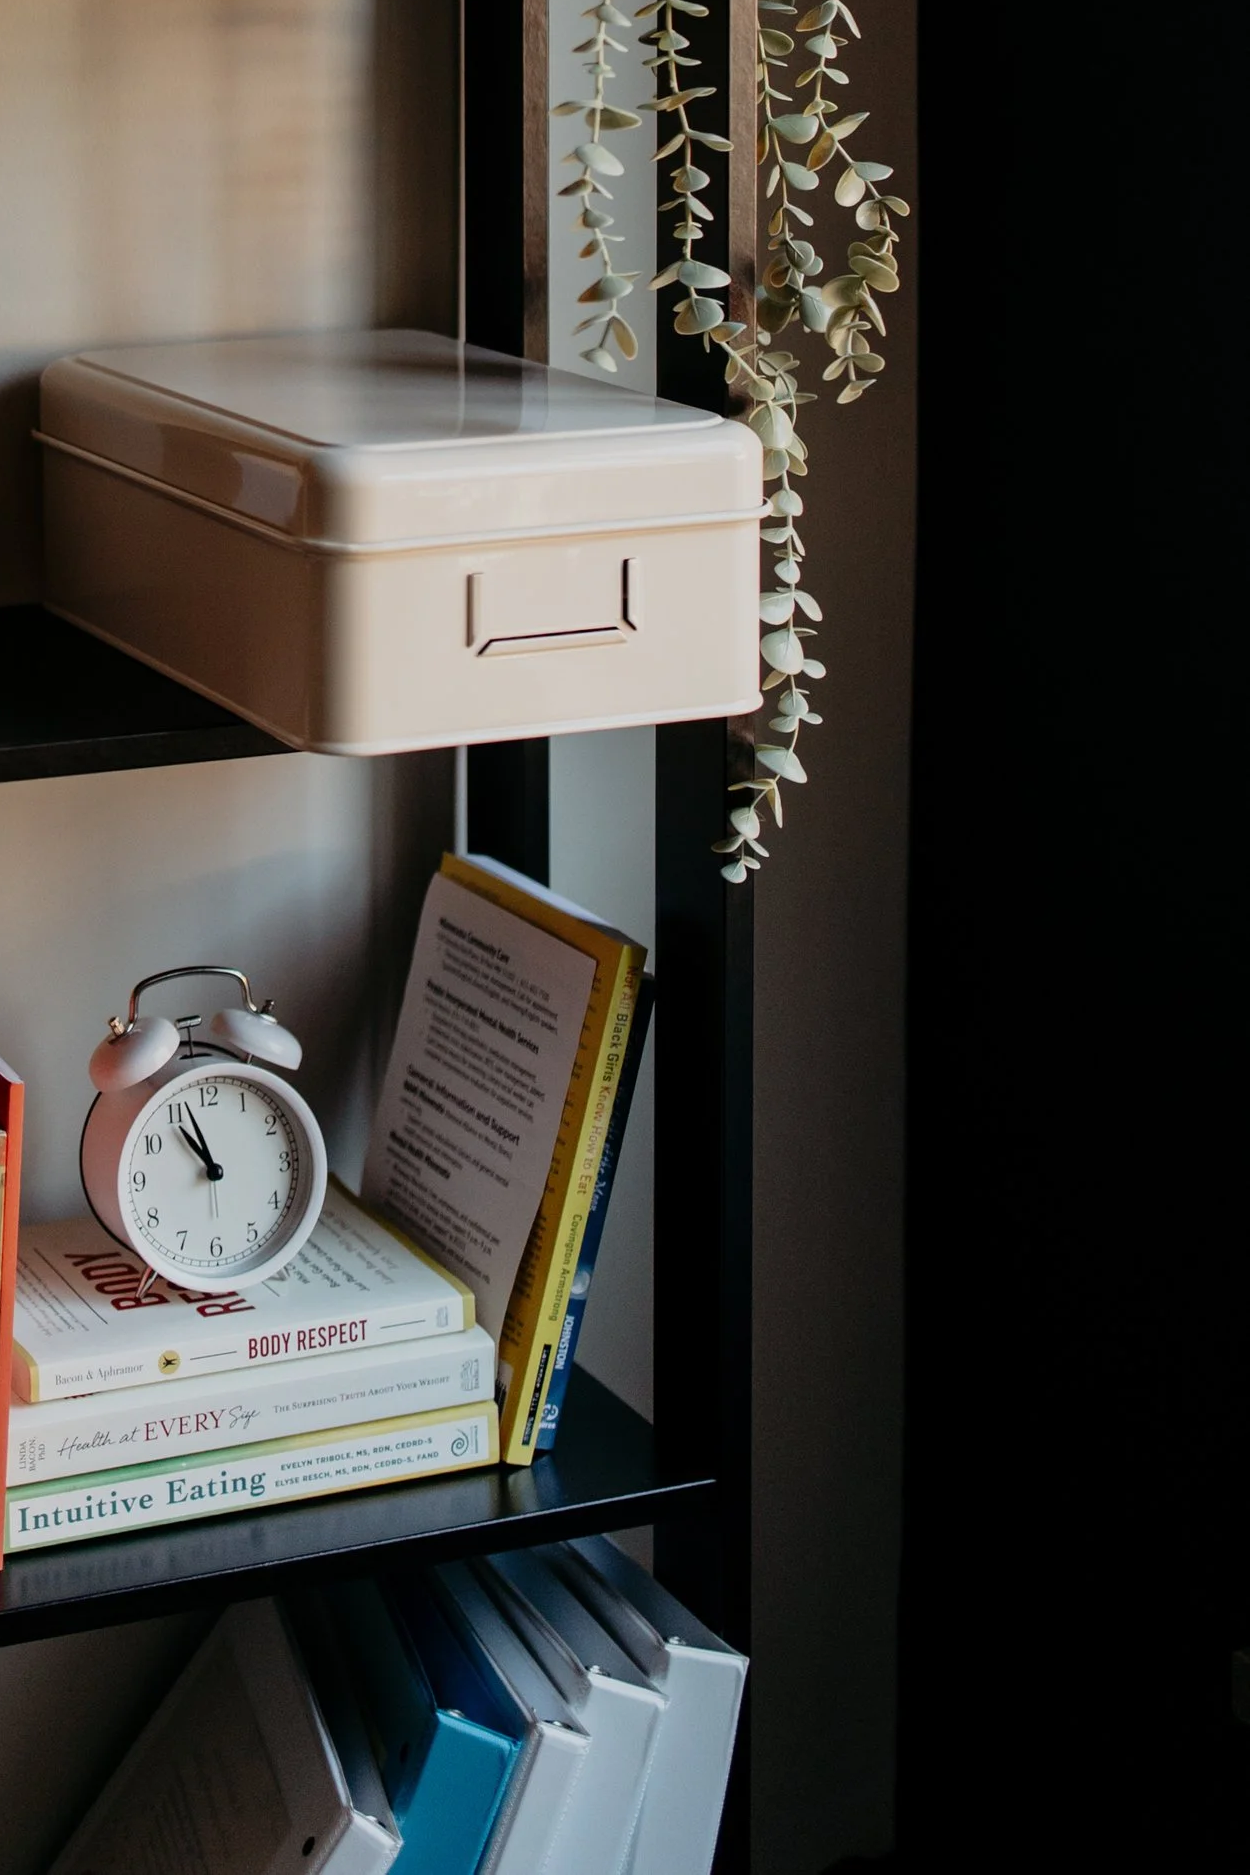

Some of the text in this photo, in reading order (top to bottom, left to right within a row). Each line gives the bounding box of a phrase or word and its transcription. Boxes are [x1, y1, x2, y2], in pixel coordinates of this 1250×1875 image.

[623, 966, 637, 989] Not
[609, 1012, 628, 1049] Black
[602, 1052, 620, 1082] Girls
[198, 1085, 218, 1107] 12
[239, 1092, 246, 1113] 1
[593, 1085, 611, 1124] Know
[167, 1103, 182, 1124] 11
[265, 1115, 278, 1136] 2
[491, 1118, 520, 1147] Support
[144, 1133, 162, 1155] 10
[587, 1125, 605, 1155] How
[279, 1151, 291, 1173] 3
[582, 1156, 595, 1172] to
[133, 1171, 146, 1192] 9
[576, 1173, 592, 1196] Eat
[267, 1191, 281, 1210] 4
[147, 1207, 160, 1228] 8
[176, 1230, 188, 1251] 7
[246, 1222, 258, 1243] 5
[210, 1237, 223, 1258] 6
[548, 1213, 583, 1322] Covington Armstrong
[248, 1319, 368, 1360] BODY RESPECT
[554, 1315, 575, 1370] JOHNSTON
[55, 1372, 84, 1386] Bacon
[86, 1370, 94, 1381] &
[57, 1431, 117, 1460] Health
[118, 1427, 140, 1444] at
[144, 1409, 226, 1442] EVERY
[280, 1458, 314, 1472] EVELYN
[356, 1448, 371, 1458] MS,
[372, 1443, 394, 1455] RDN,
[395, 1436, 434, 1451] CEDRD-S
[17, 1470, 266, 1533] Intuitive Eating
